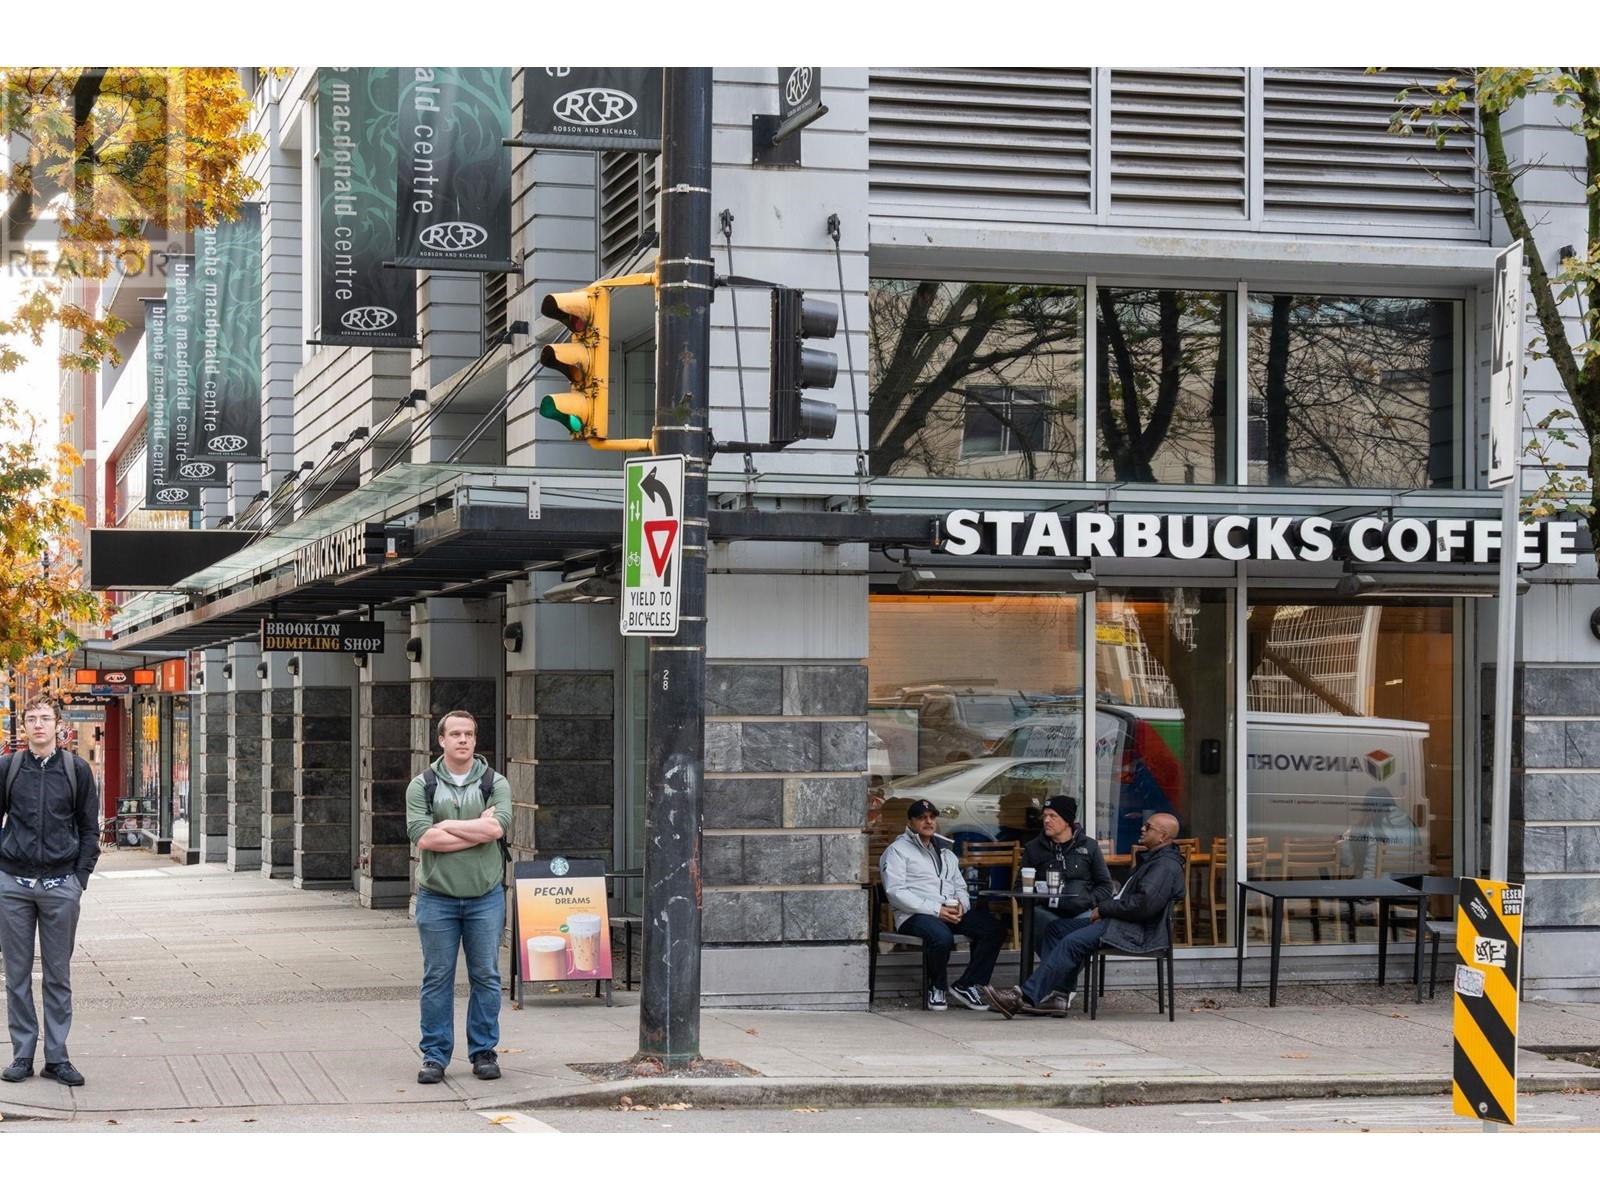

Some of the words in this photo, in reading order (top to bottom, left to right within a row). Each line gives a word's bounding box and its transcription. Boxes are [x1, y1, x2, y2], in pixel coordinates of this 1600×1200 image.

[556, 90, 633, 124] R&R
[553, 125, 581, 133] ROBSON
[332, 84, 357, 216] macdonald
[413, 124, 439, 214] centre
[422, 223, 483, 251] R&R
[334, 226, 357, 300] centre
[175, 264, 190, 322] blanche
[152, 306, 167, 360] blanche
[204, 283, 220, 374] macdonald
[343, 308, 394, 331] R&R
[176, 328, 191, 410] macdonald
[153, 366, 167, 439] macdonald
[204, 382, 220, 432] centre
[175, 415, 190, 461] centre
[210, 436, 246, 451] R&R
[153, 444, 168, 486] centre
[181, 463, 214, 478] R&R
[157, 489, 187, 501] R&R
[294, 534, 335, 588] STARBUCKS
[335, 523, 367, 575] COFFEE
[944, 509, 1334, 562] STARBUCKS
[1348, 517, 1577, 564] COFFEE
[630, 591, 656, 606] YIELD
[660, 591, 672, 606] TO
[266, 622, 341, 636] BROOKLYN
[629, 611, 671, 627] BICYCLES
[266, 637, 340, 649] DUMPLING
[344, 638, 381, 650] SHOP
[534, 886, 574, 896] PECAN
[555, 897, 591, 905] DREAMS
